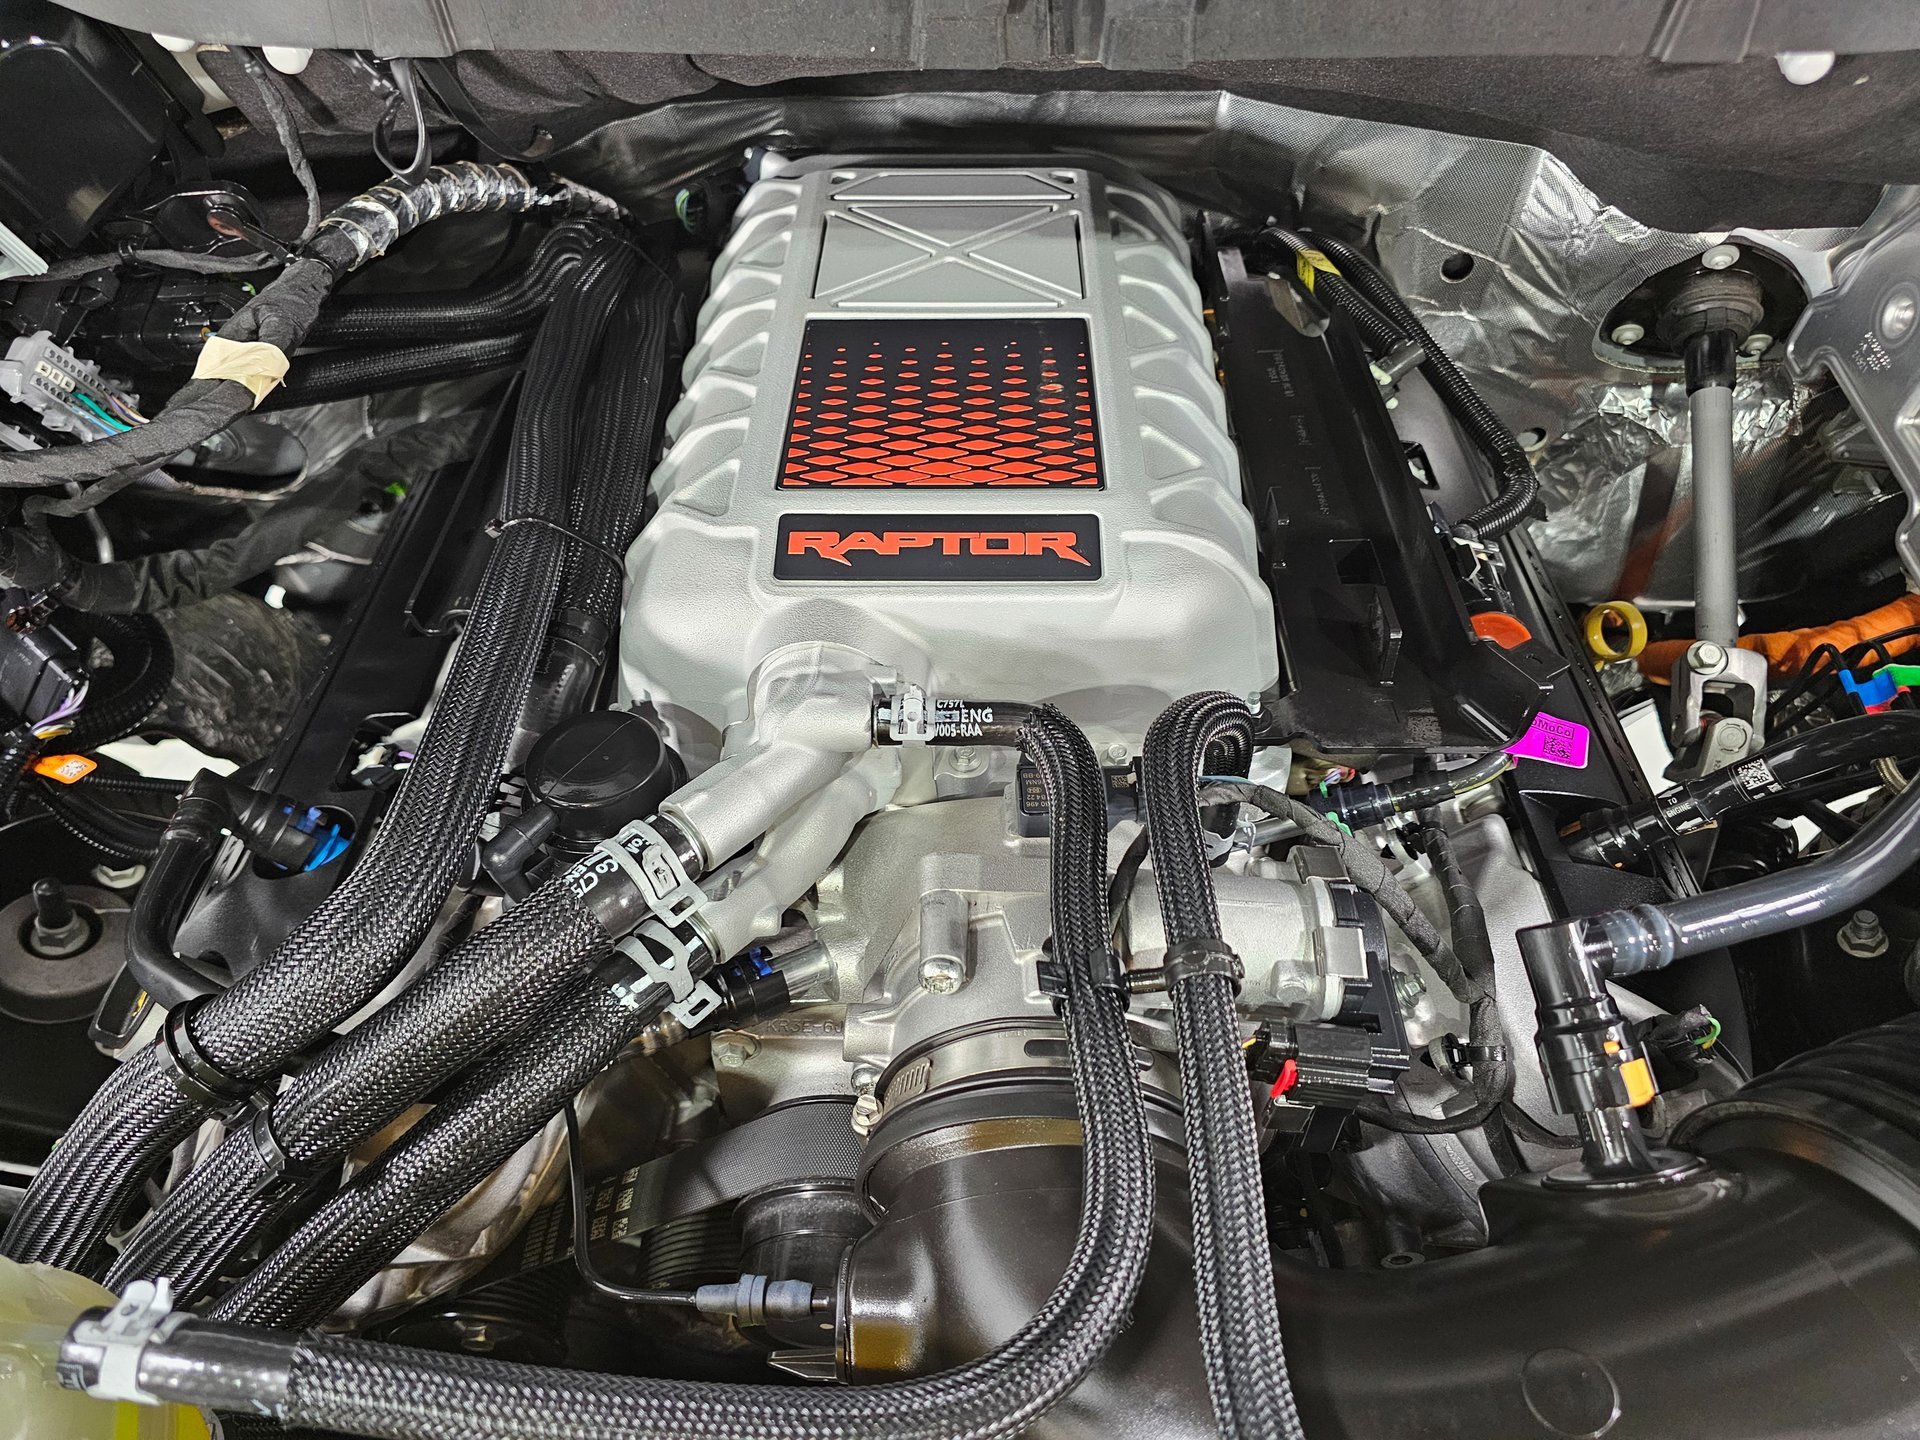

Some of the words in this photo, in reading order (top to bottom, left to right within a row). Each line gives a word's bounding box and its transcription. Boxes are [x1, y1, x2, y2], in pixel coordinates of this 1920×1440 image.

[787, 531, 1092, 567] RAPTOR
[961, 707, 994, 723] ENG
[1532, 719, 1571, 737] oMoCo
[1667, 797, 1678, 806] TO
[1666, 802, 1692, 818] ENGINE
